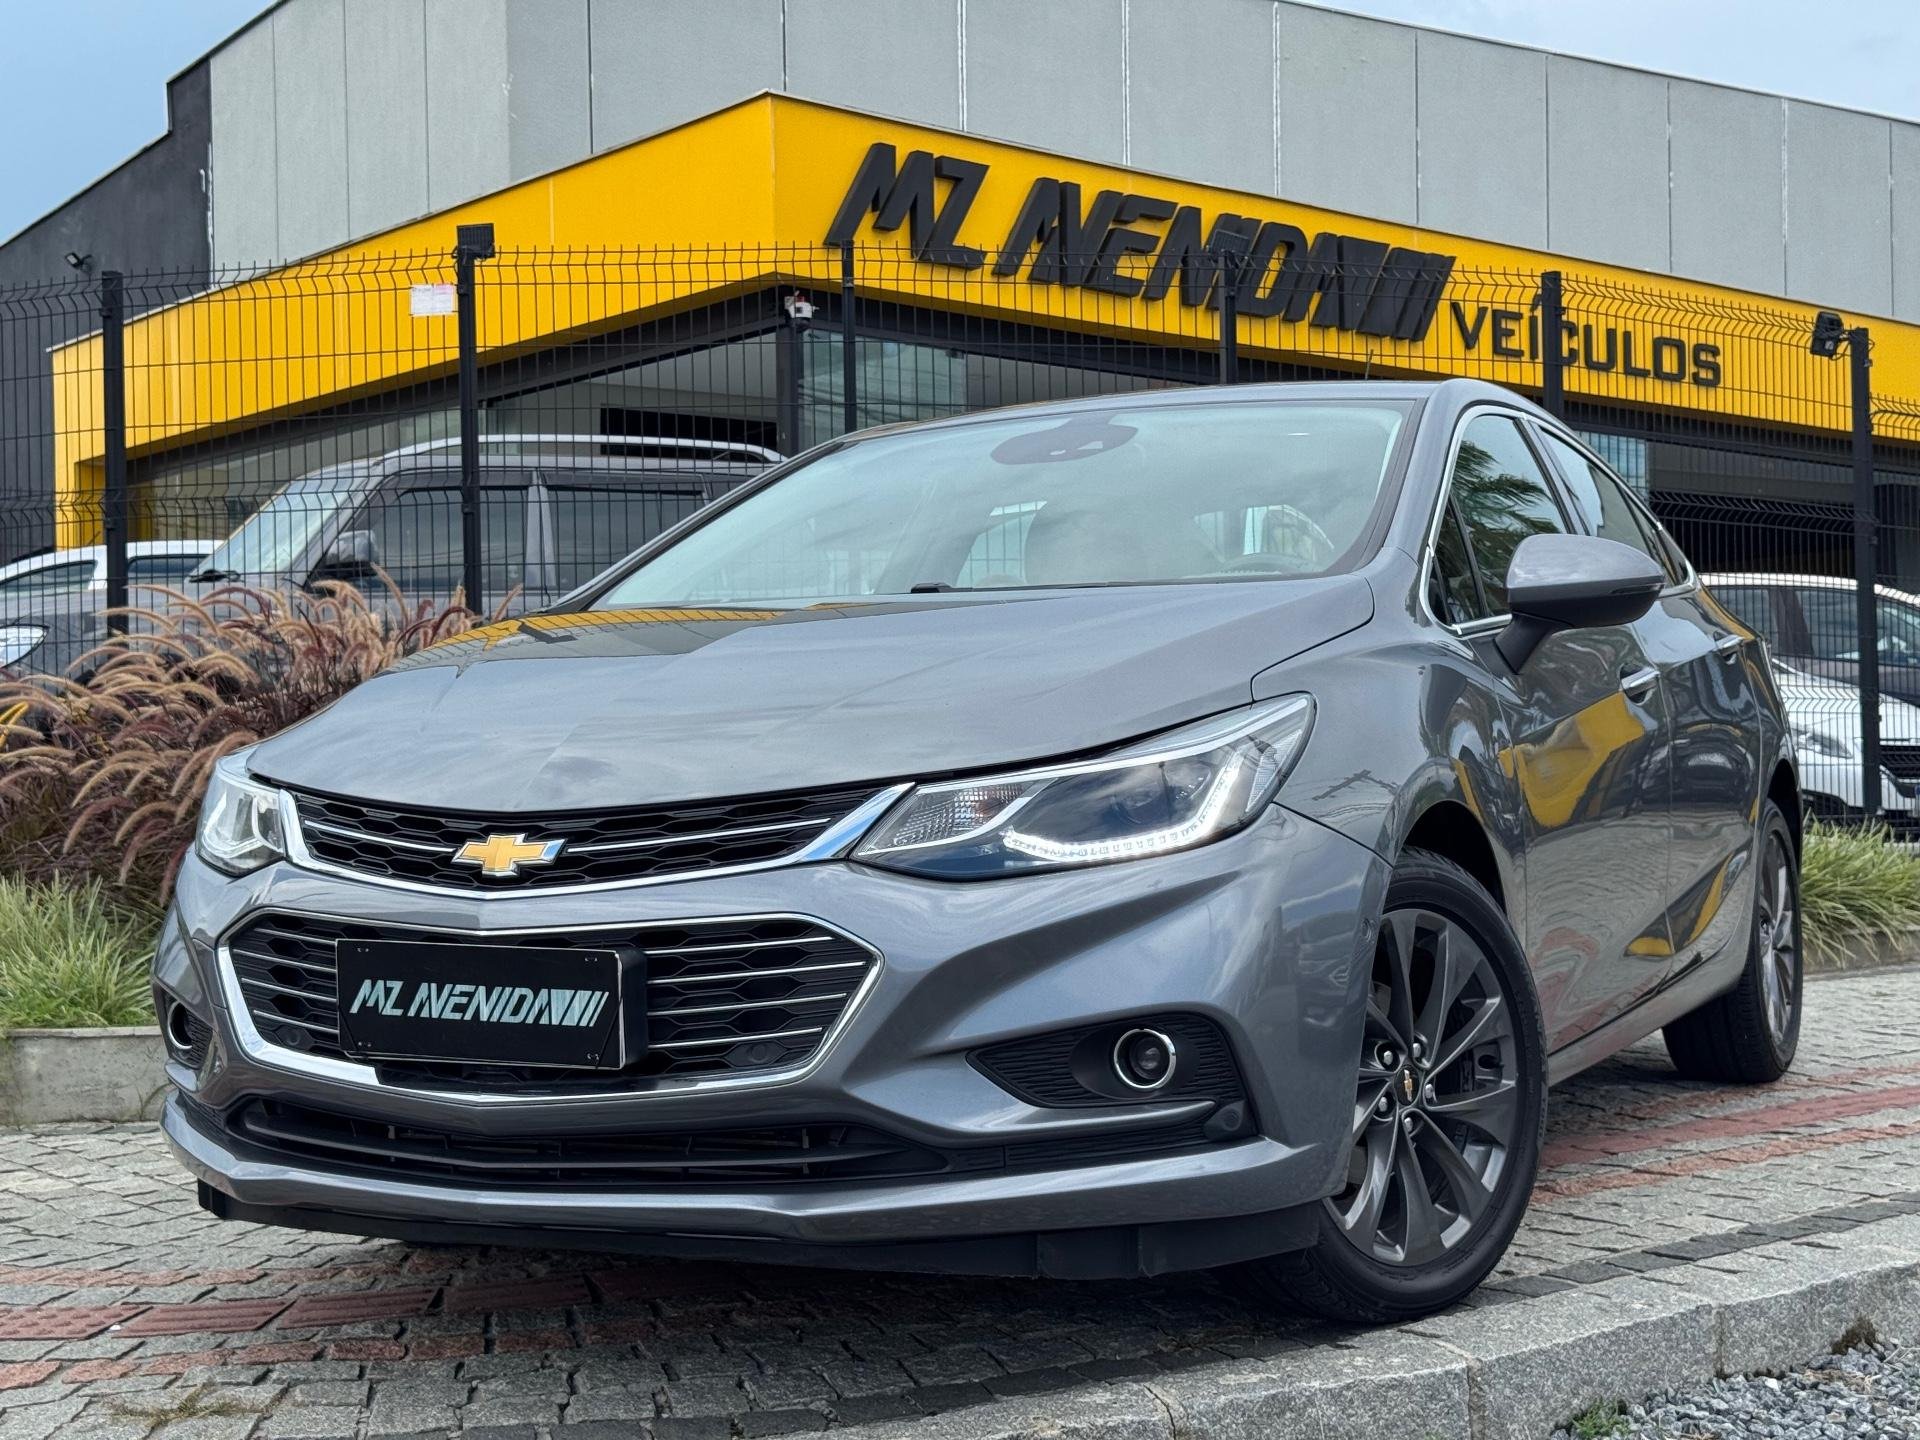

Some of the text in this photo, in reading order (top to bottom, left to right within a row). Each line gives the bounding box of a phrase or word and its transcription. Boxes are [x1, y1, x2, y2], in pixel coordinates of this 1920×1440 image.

[824, 142, 1392, 334] MZ AVENIDA
[350, 979, 580, 1027] MZ AVENIDA
